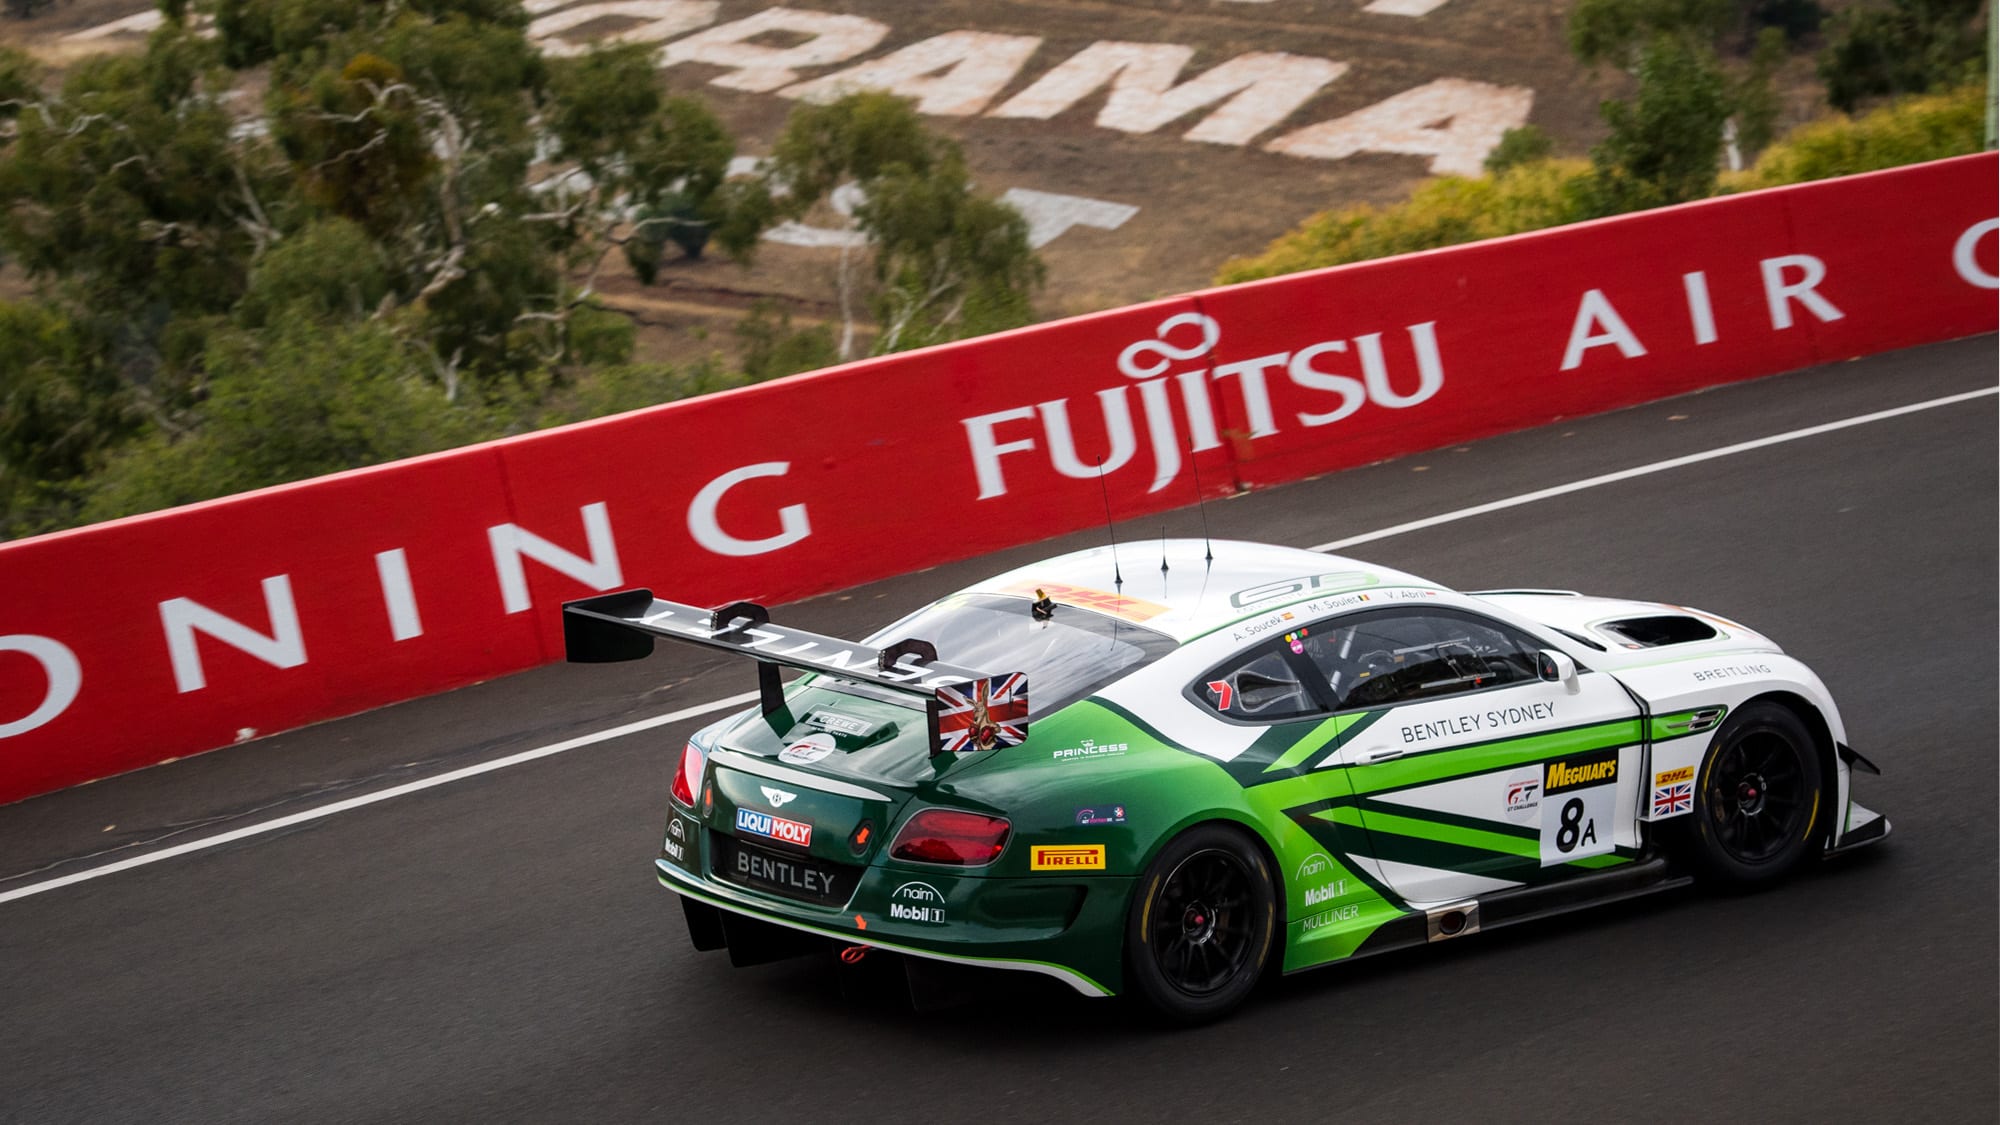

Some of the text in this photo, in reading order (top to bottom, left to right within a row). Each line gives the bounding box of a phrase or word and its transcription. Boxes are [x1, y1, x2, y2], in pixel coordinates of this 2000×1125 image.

[961, 321, 1444, 500] FUJITSU
[1560, 253, 1846, 371] AIR
[1308, 604, 1323, 613] M.
[1233, 616, 1282, 641] A. Soucek
[1693, 664, 1771, 681] BREITLING
[1401, 702, 1554, 743] BENTLEY SYDNEY
[1053, 743, 1128, 759] PRINCESS
[1660, 769, 1690, 783] DHL
[738, 811, 810, 843] LIQUI MOLY
[1038, 849, 1099, 866] PIRELLI
[738, 851, 835, 895] BENTLEY
[1303, 860, 1325, 876] naim
[903, 888, 934, 901] naim
[1305, 882, 1335, 907] Mobil
[890, 903, 930, 921] Mobil
[1303, 905, 1359, 933] MULLINER
